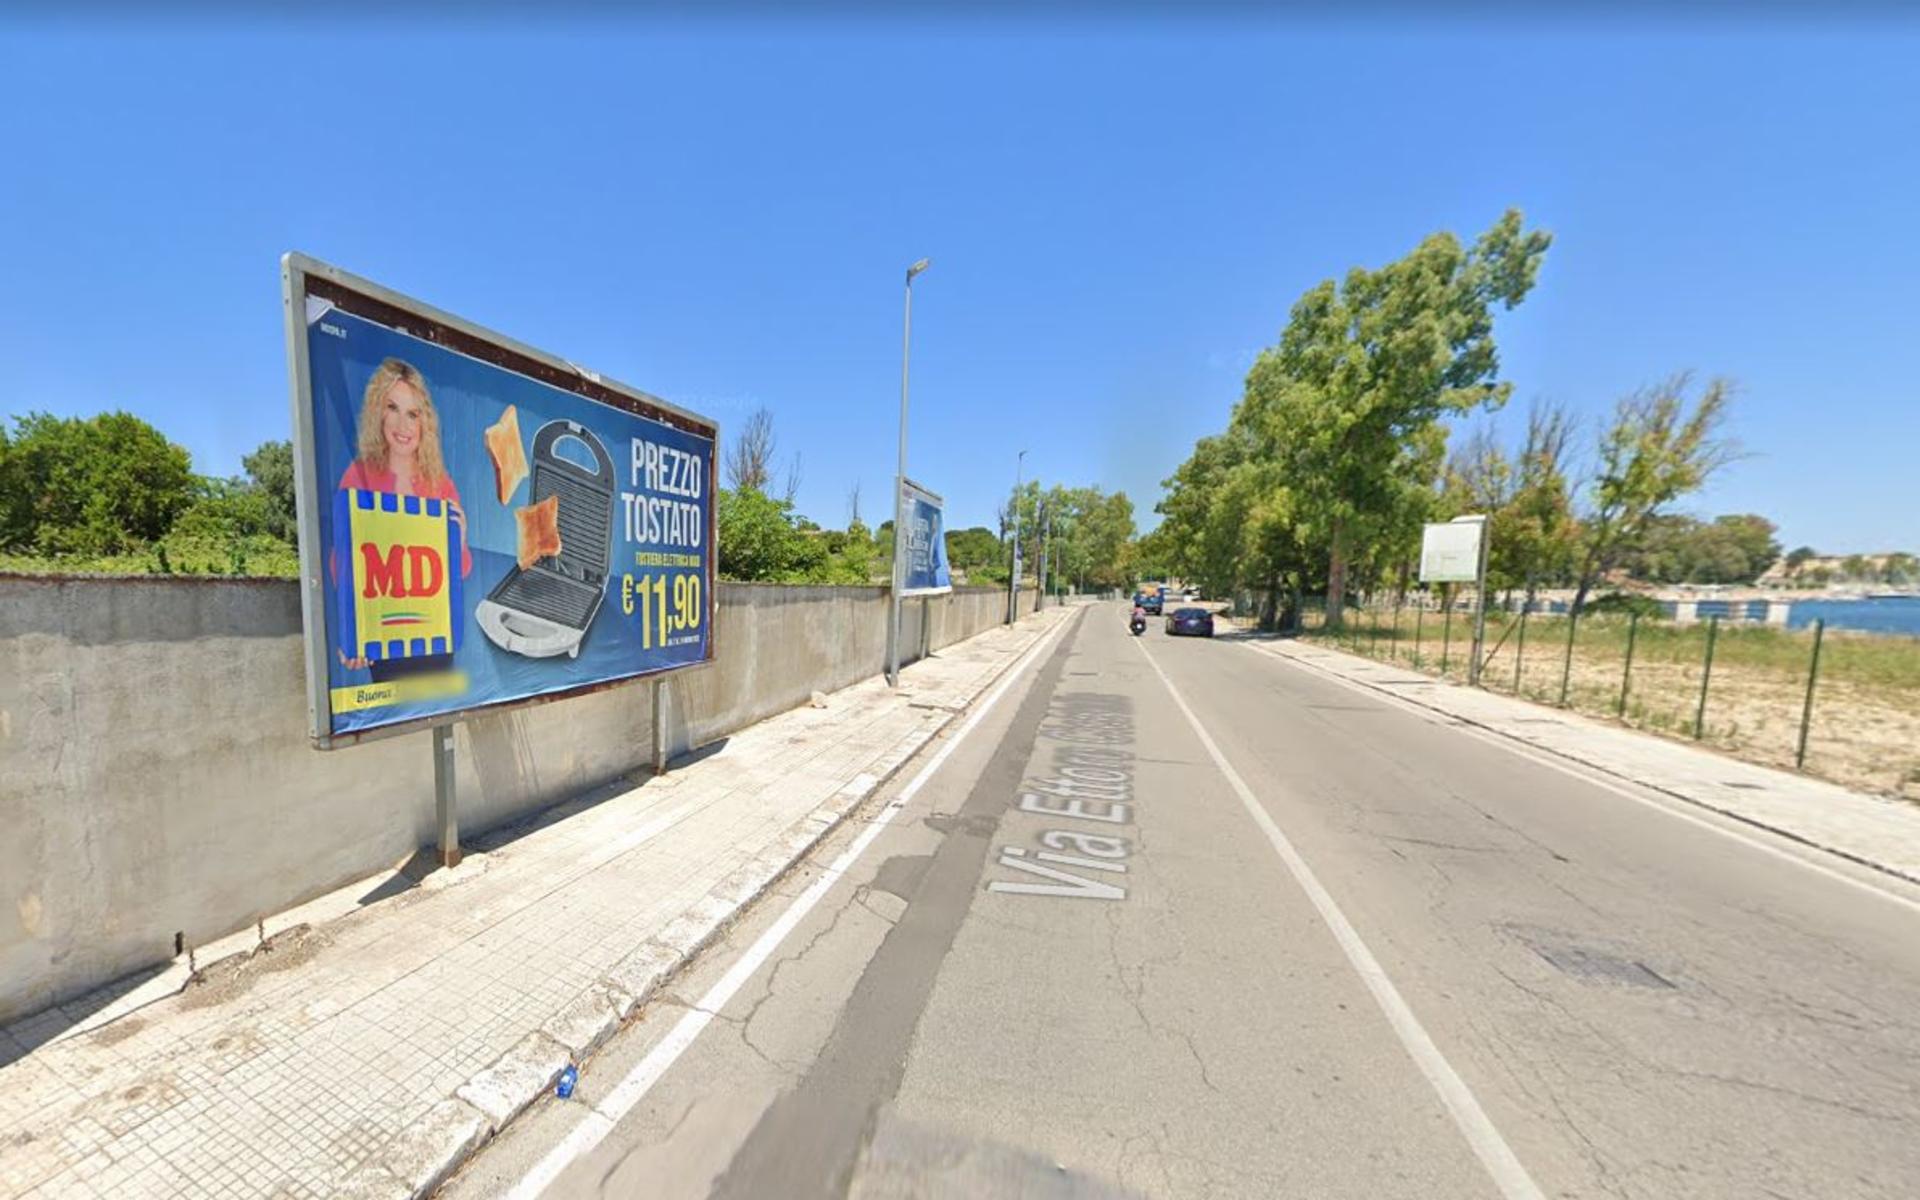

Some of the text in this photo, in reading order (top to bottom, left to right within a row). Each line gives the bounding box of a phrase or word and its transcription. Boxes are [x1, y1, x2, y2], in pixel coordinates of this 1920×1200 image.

[631, 437, 701, 499] PREZZO
[621, 492, 701, 548] TOSTATO
[360, 542, 444, 599] MD
